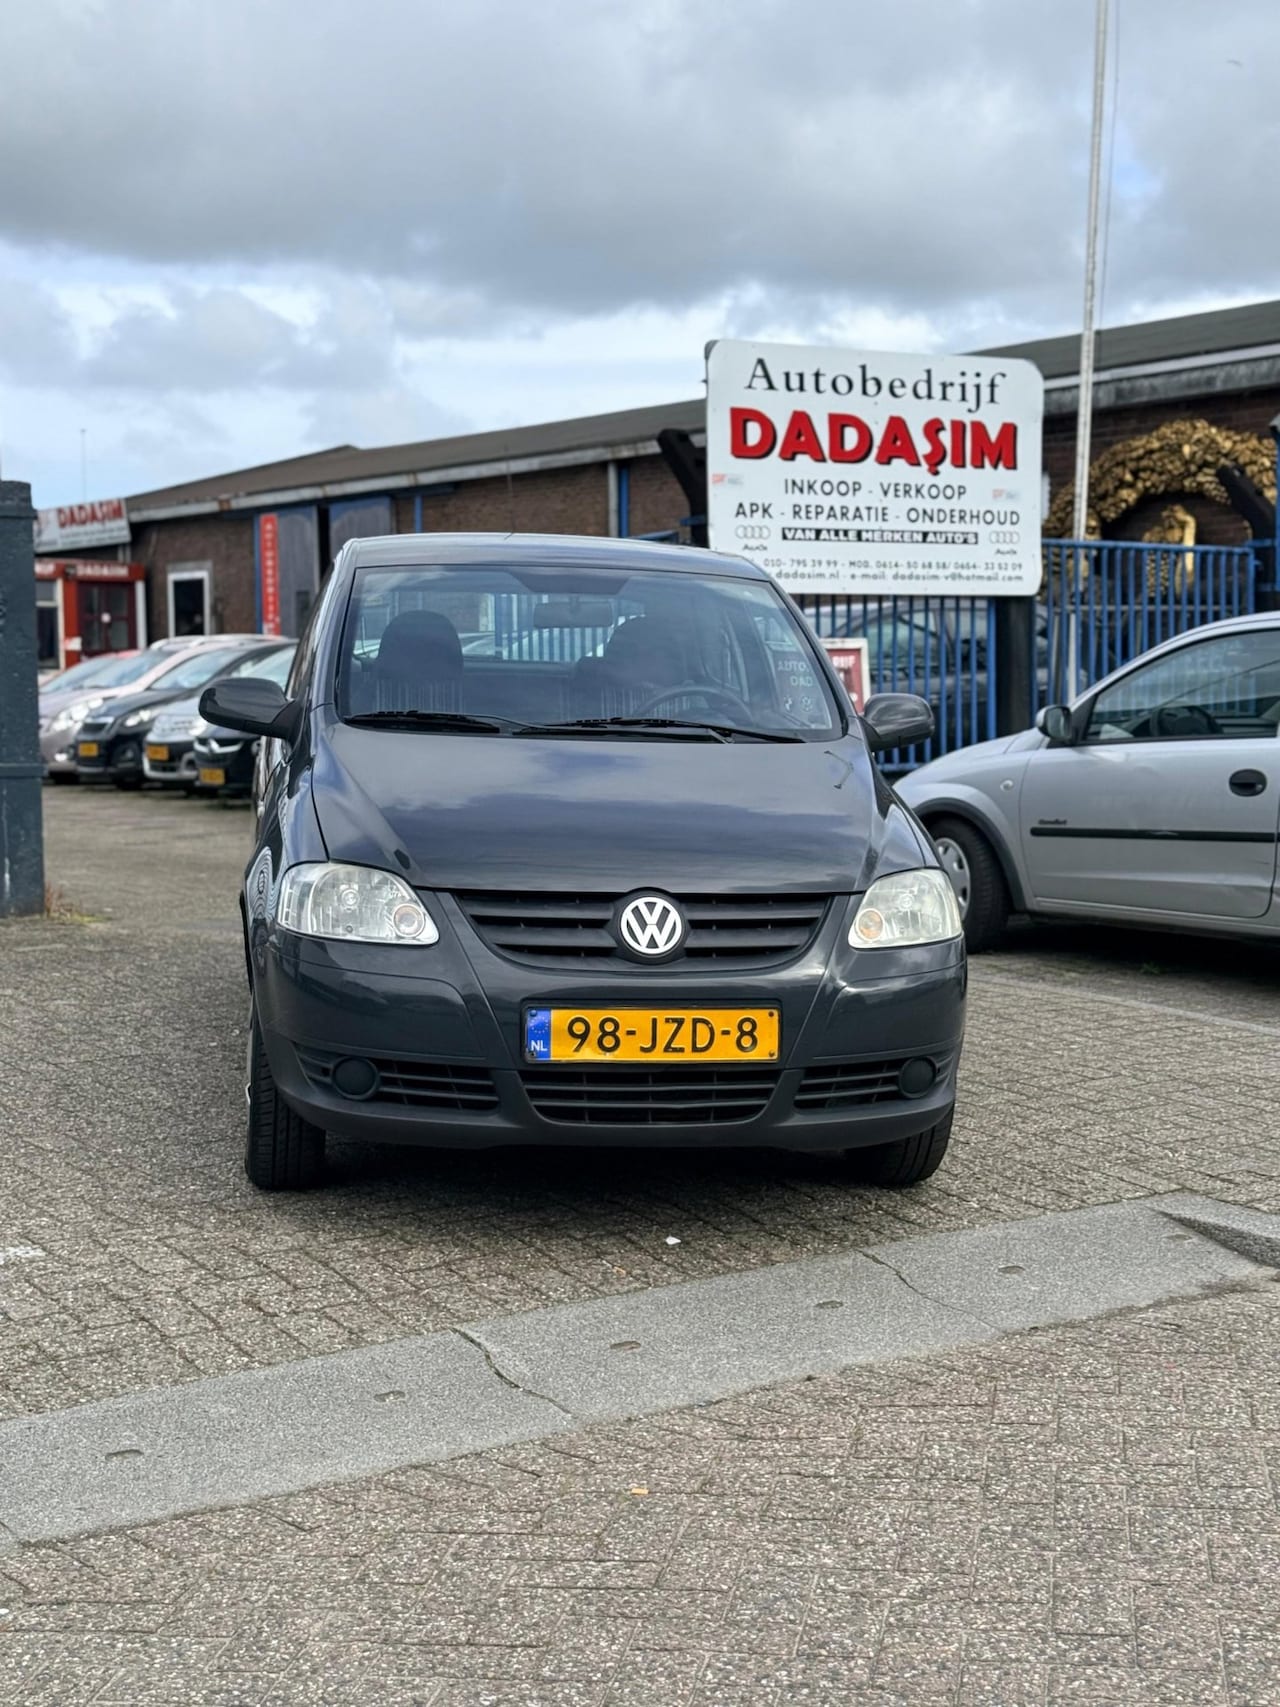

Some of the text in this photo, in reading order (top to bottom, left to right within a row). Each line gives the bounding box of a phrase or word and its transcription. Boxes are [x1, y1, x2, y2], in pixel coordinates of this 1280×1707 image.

[745, 357, 1008, 413] Autobedrijf
[729, 406, 1018, 475] DADAŞIM
[784, 478, 862, 497] INKOOP
[880, 481, 967, 500] VERKOOP
[734, 502, 774, 519] APK
[792, 503, 889, 522] REPARATIE
[906, 507, 1021, 526] ONDERHOUD
[784, 528, 977, 544] VAN ALLE MERKEN AUTO'S
[530, 1016, 759, 1054] NL 98-JZD-8
